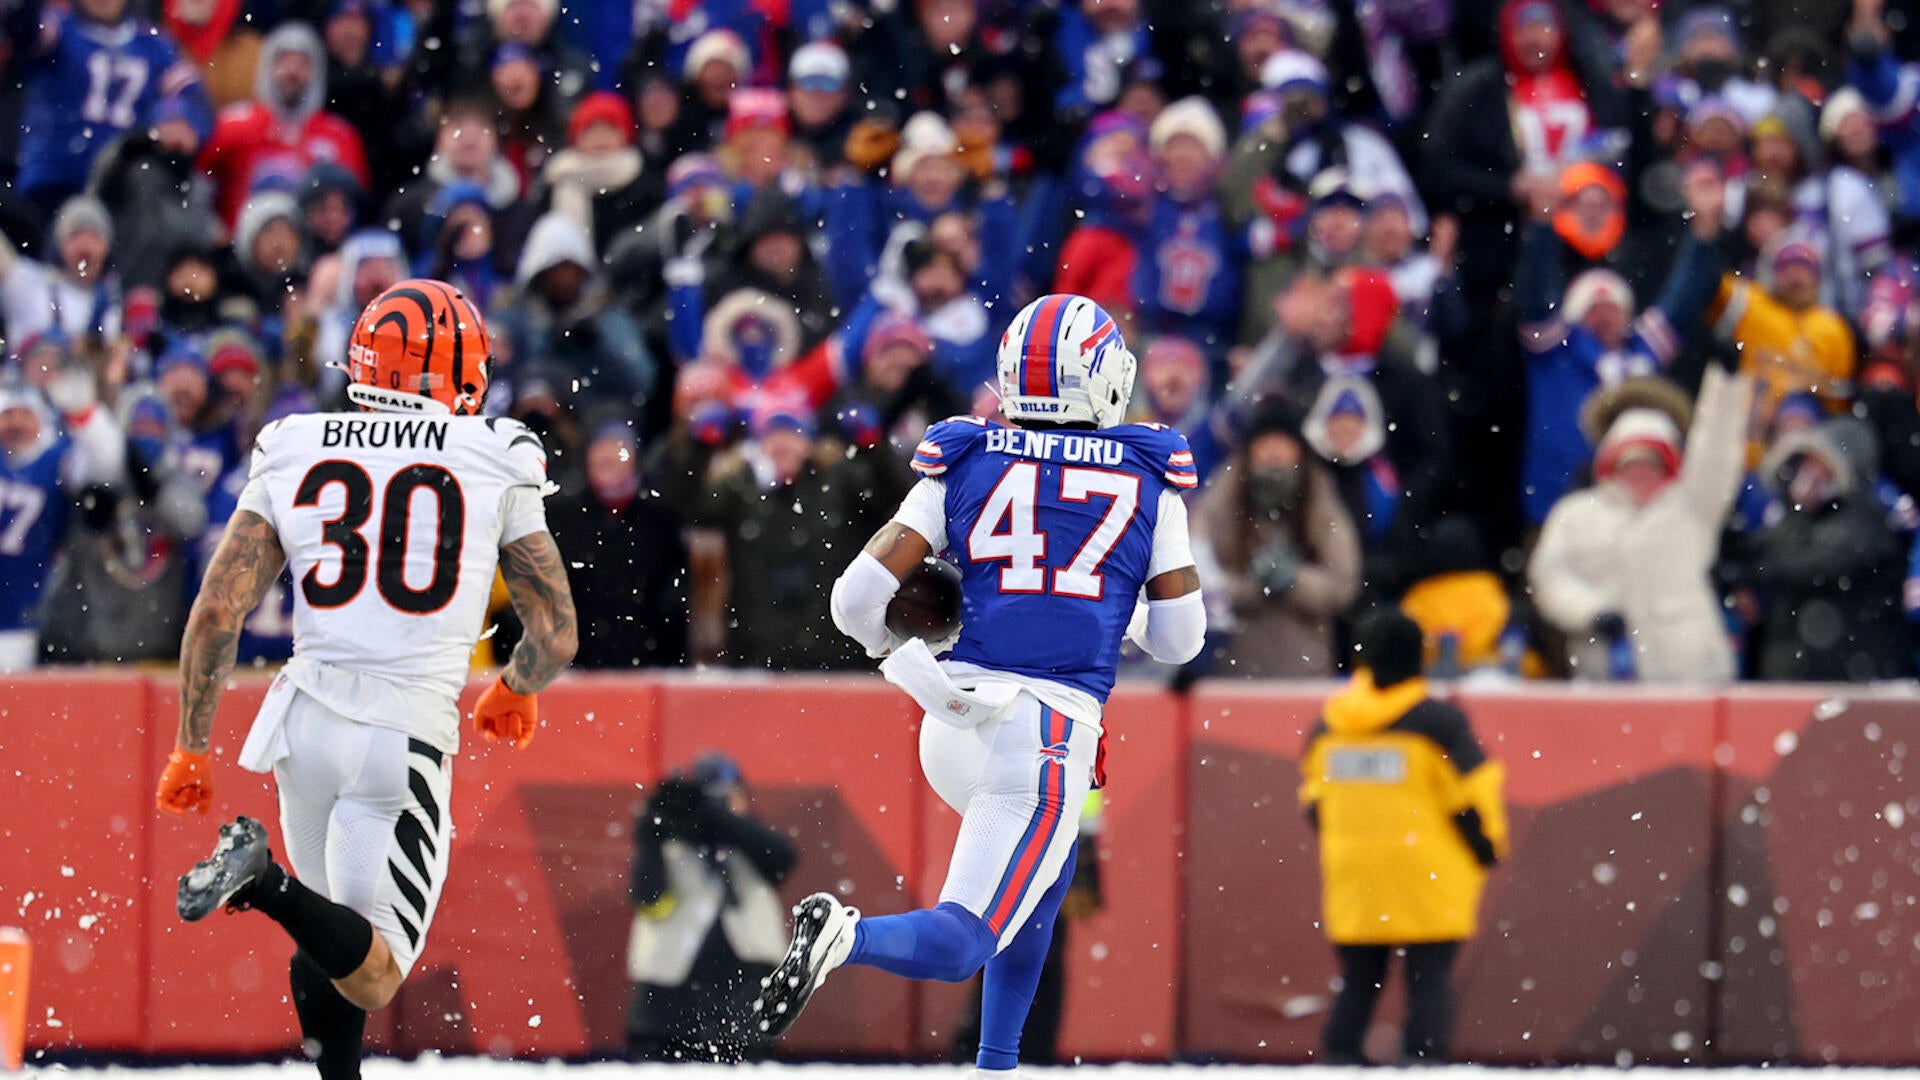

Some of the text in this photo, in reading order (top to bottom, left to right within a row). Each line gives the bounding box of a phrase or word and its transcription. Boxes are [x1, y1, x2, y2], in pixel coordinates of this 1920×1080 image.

[83, 50, 150, 129] 17
[353, 391, 423, 410] BENGALS
[1020, 402, 1059, 413] BILLS
[321, 419, 449, 451] BROWN
[984, 427, 1124, 466] BENFORD
[292, 458, 466, 616] 30
[966, 459, 1142, 601] 47
